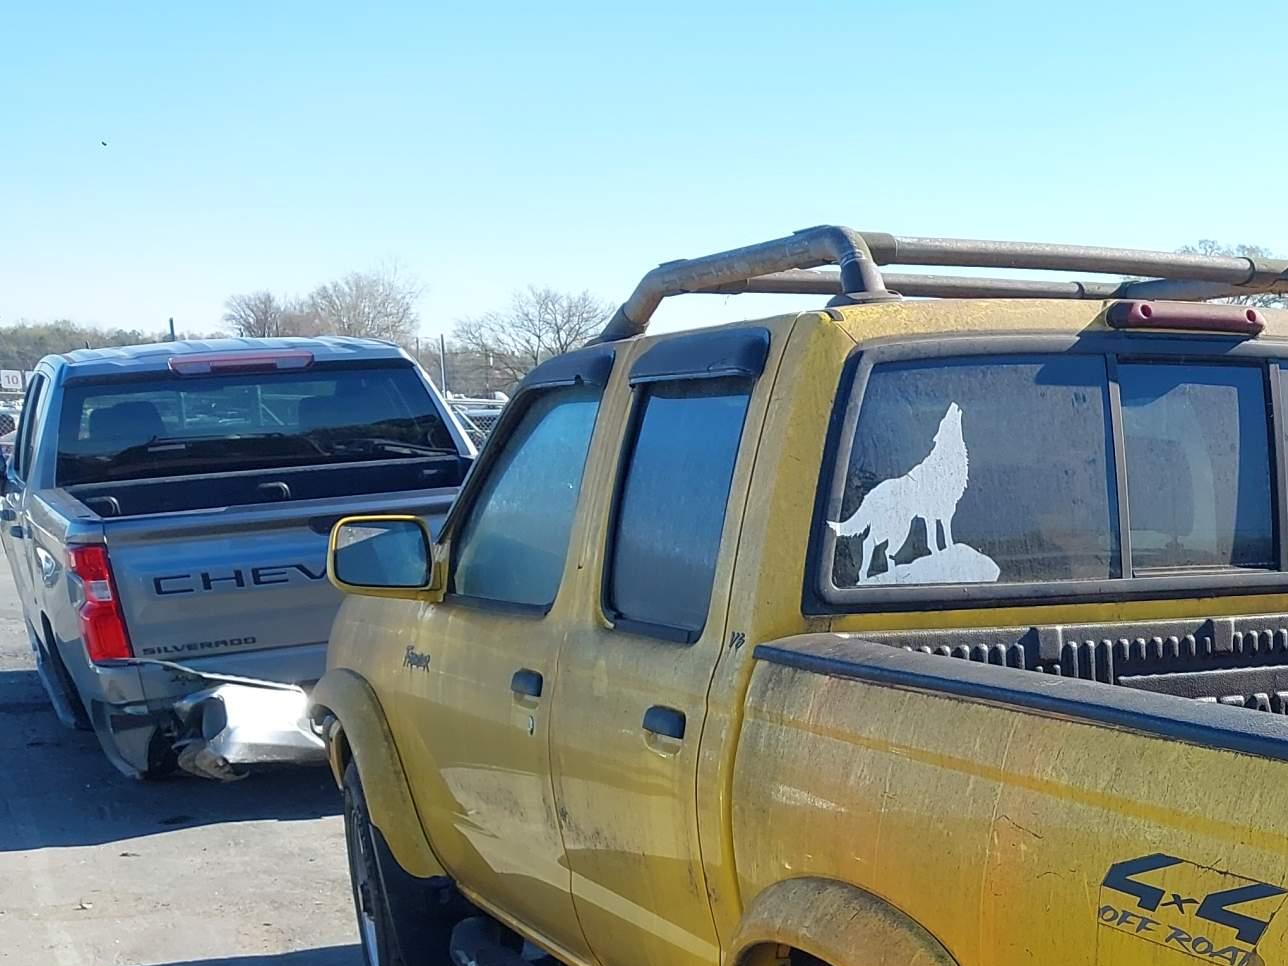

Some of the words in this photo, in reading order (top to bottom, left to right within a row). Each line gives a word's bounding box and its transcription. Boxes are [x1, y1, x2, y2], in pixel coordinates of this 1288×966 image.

[5, 375, 19, 385] 10
[143, 636, 257, 656] SILVERADO
[1100, 904, 1161, 934] OFF
